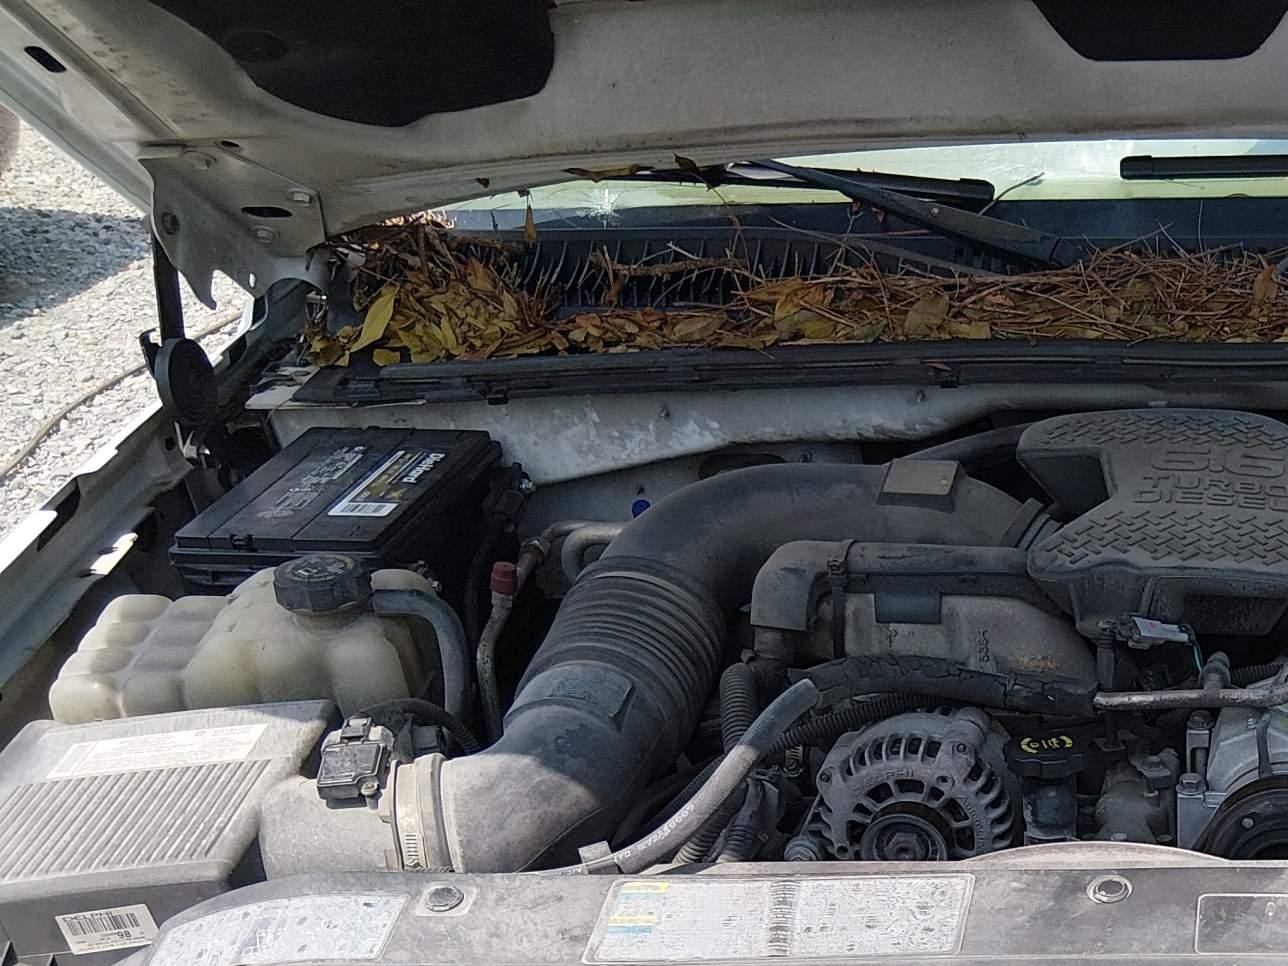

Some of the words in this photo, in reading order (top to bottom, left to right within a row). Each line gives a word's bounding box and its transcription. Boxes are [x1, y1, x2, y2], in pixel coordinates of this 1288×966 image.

[400, 453, 446, 483] DieHard
[637, 803, 695, 851] GOODYEAR
[62, 911, 112, 922] DELPHI
[117, 930, 131, 939] 98
